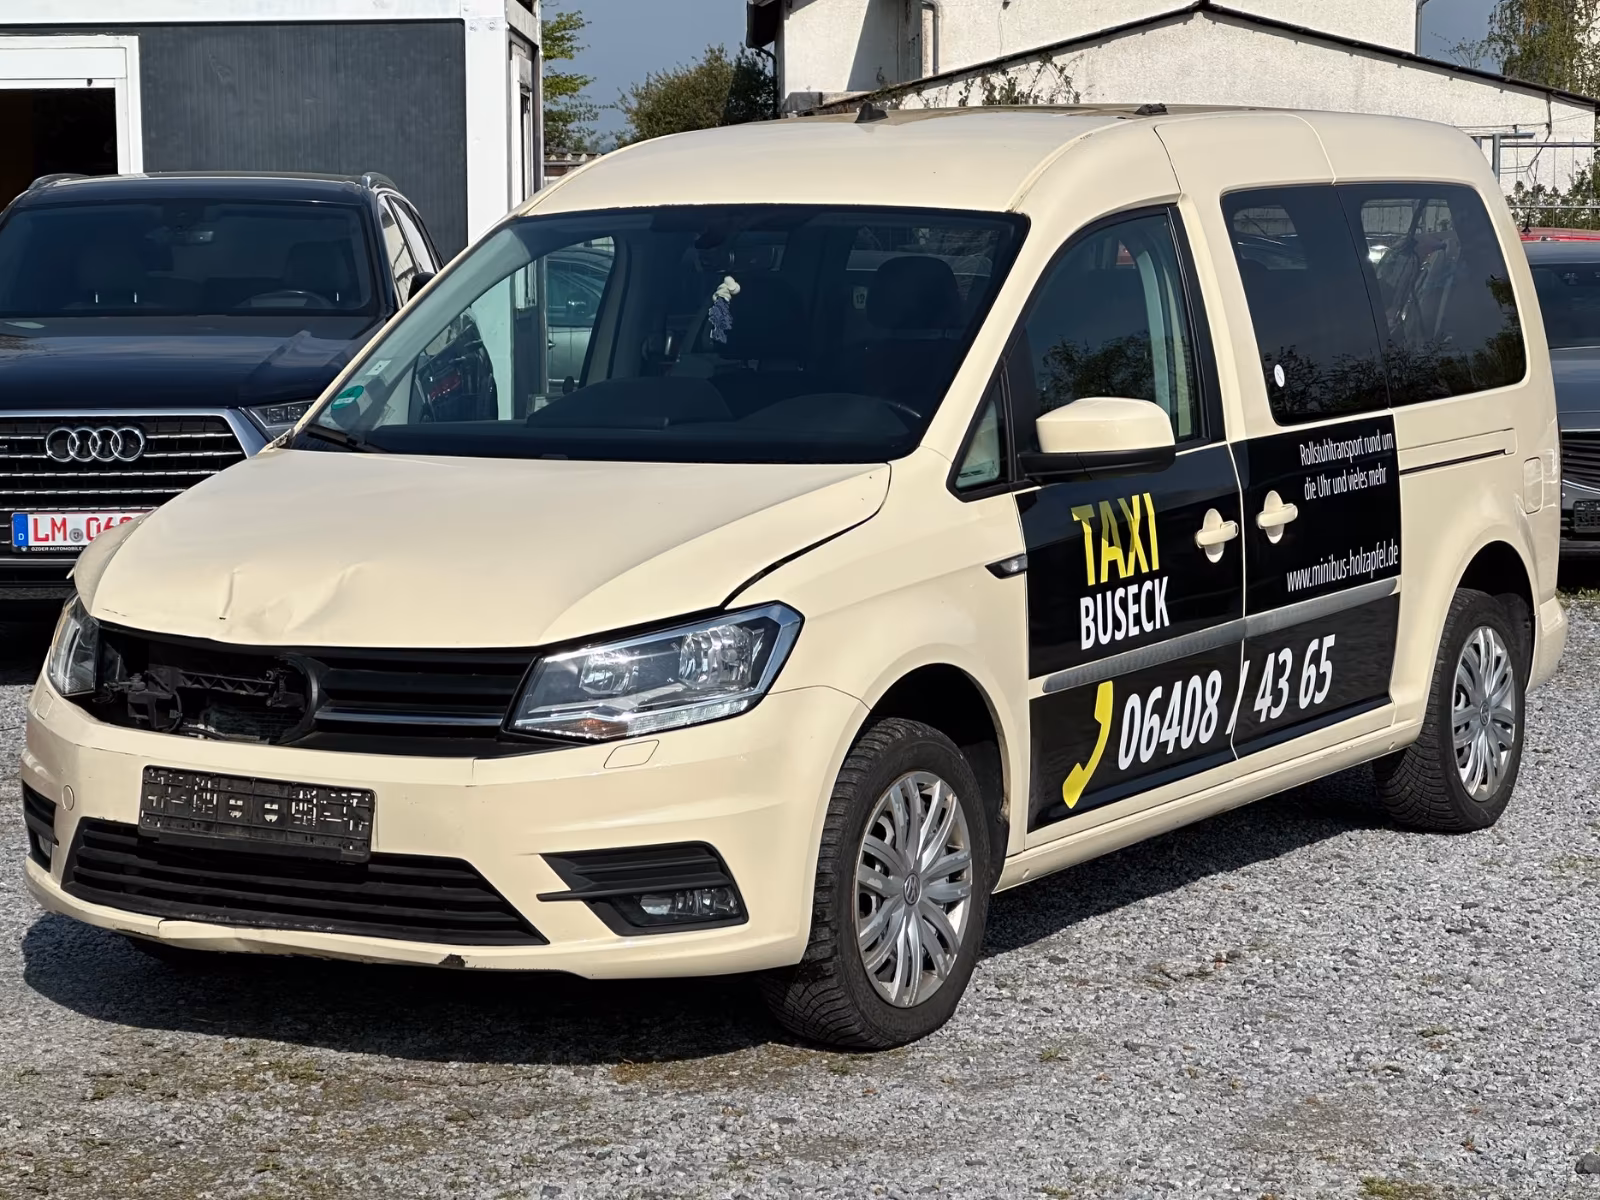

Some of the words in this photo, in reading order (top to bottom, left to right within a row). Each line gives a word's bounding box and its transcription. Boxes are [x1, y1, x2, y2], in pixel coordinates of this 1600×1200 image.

[1300, 435, 1364, 466] Rollstuhltransport
[1364, 429, 1381, 454] rund
[1382, 433, 1394, 450] um
[1304, 477, 1317, 500] die
[1317, 474, 1331, 497] Uhr
[1332, 469, 1348, 494] und
[1347, 467, 1368, 490] vieles
[1368, 462, 1387, 486] mehr
[18, 533, 25, 541] D
[32, 517, 67, 542] LM
[1071, 492, 1160, 586] TAXI
[1286, 538, 1399, 592] www.minibus-holzapfel.de
[1080, 576, 1170, 651] BUSECK
[1118, 670, 1222, 771] 06408
[1254, 647, 1293, 723] 43
[1299, 634, 1336, 710] 65
